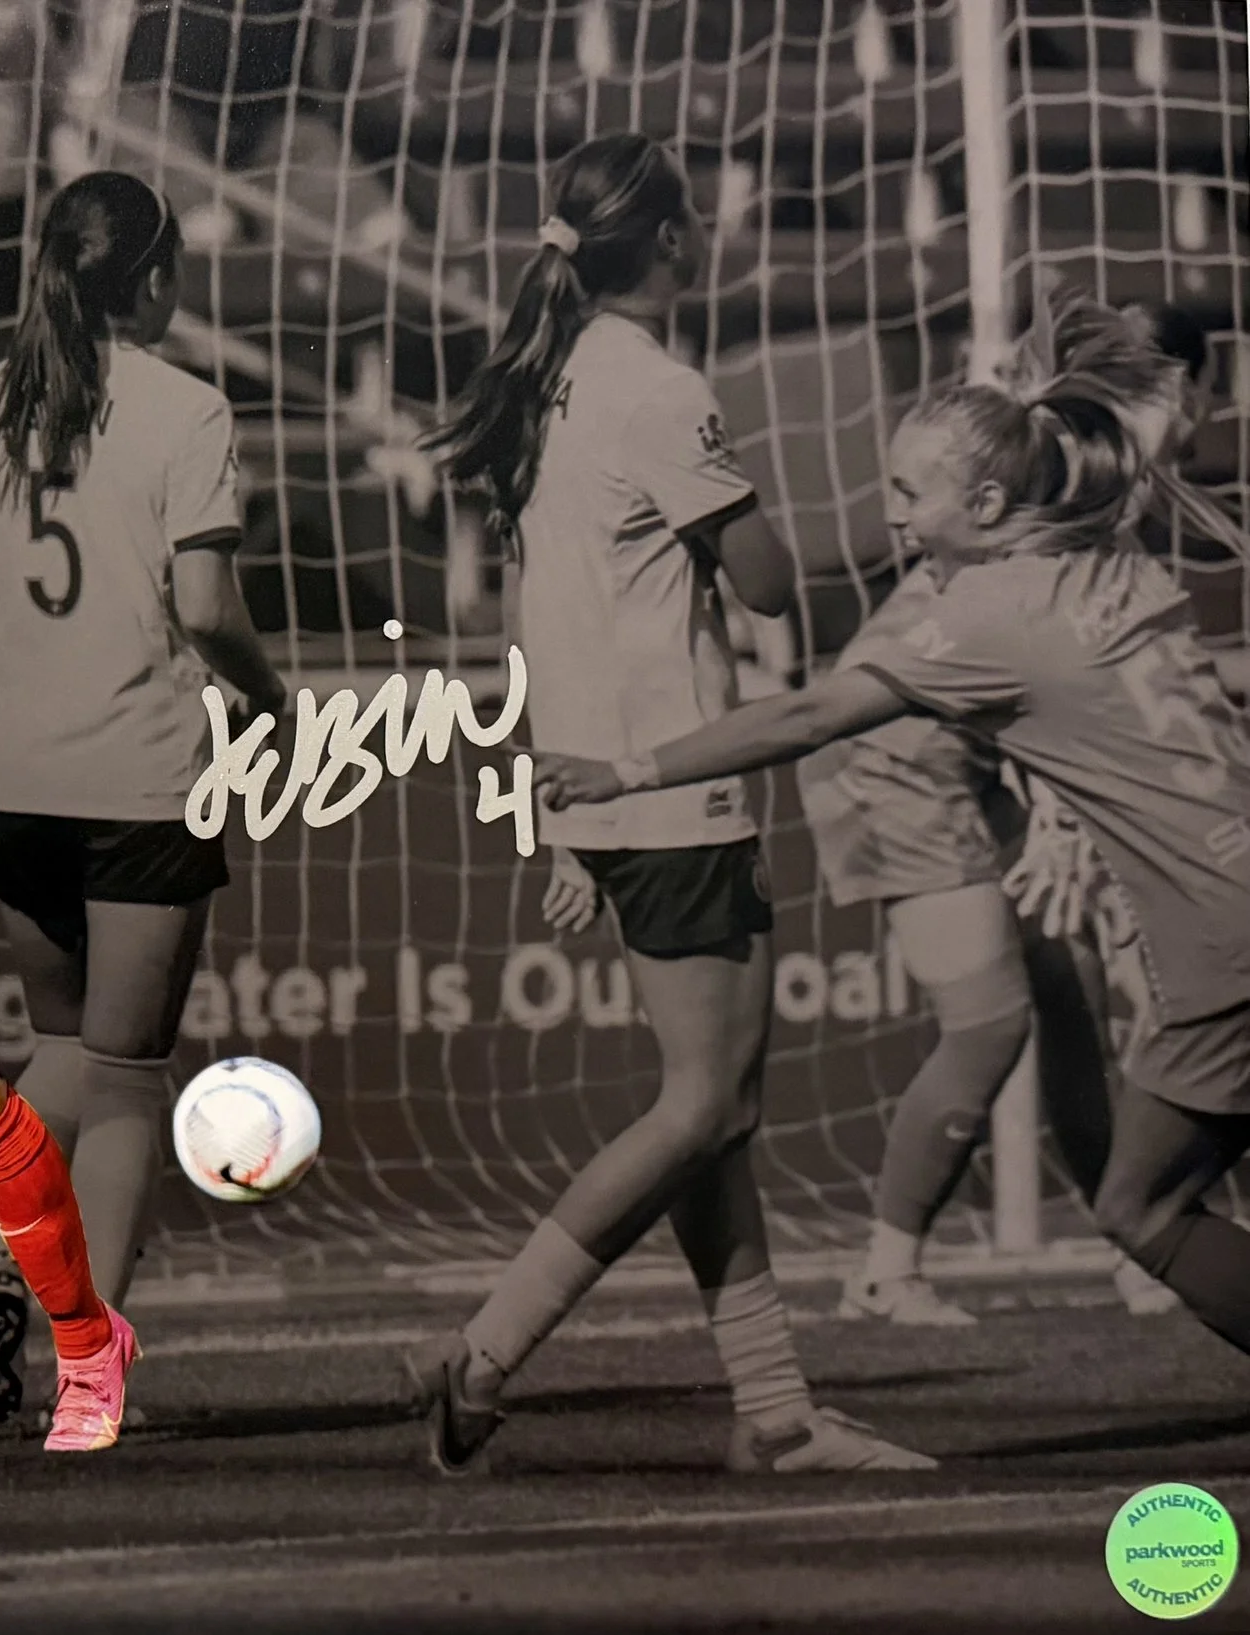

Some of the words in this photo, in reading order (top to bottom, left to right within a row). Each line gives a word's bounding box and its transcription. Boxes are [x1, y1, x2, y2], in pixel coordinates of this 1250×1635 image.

[24, 468, 82, 619] 5
[476, 754, 535, 857] 4
[180, 951, 367, 1040] ater
[396, 945, 473, 1034] Is
[500, 943, 650, 1030] Ou
[774, 934, 908, 1022] oal
[1127, 1494, 1222, 1527] AUTHENTIC
[1125, 1539, 1224, 1563] parkwood
[1181, 1559, 1217, 1568] SPORTS
[1126, 1573, 1223, 1605] AUTHENTIC
